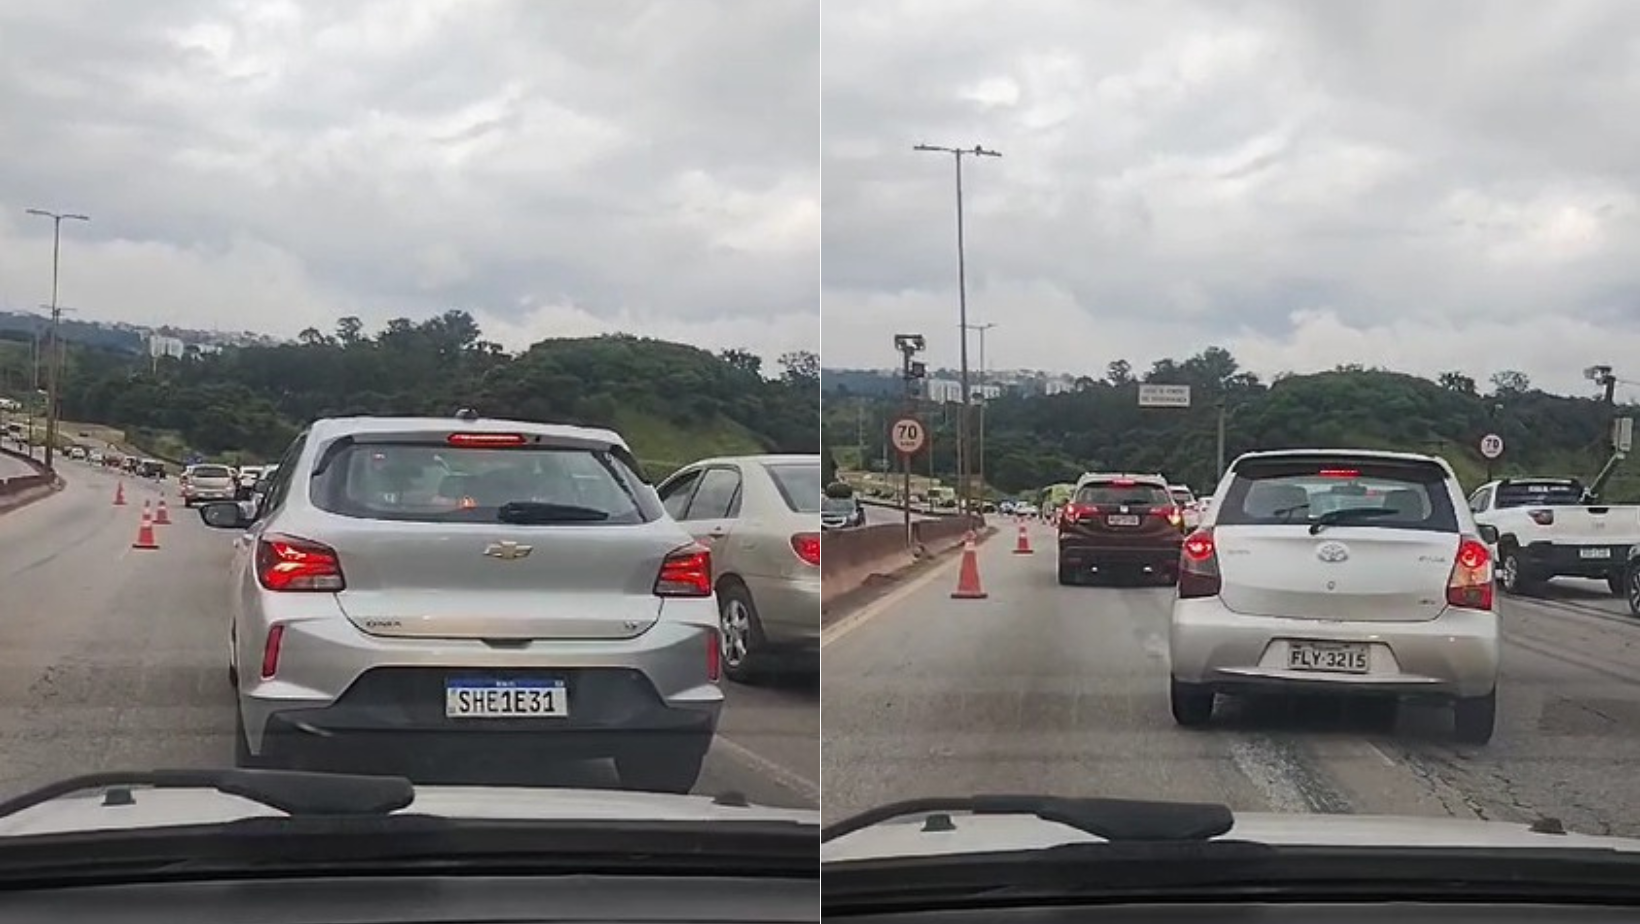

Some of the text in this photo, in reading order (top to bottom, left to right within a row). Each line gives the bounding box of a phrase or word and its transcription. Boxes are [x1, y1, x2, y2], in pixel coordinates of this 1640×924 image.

[898, 425, 917, 440] 70
[1485, 438, 1500, 449] 70
[459, 690, 555, 713] SHE1E31
